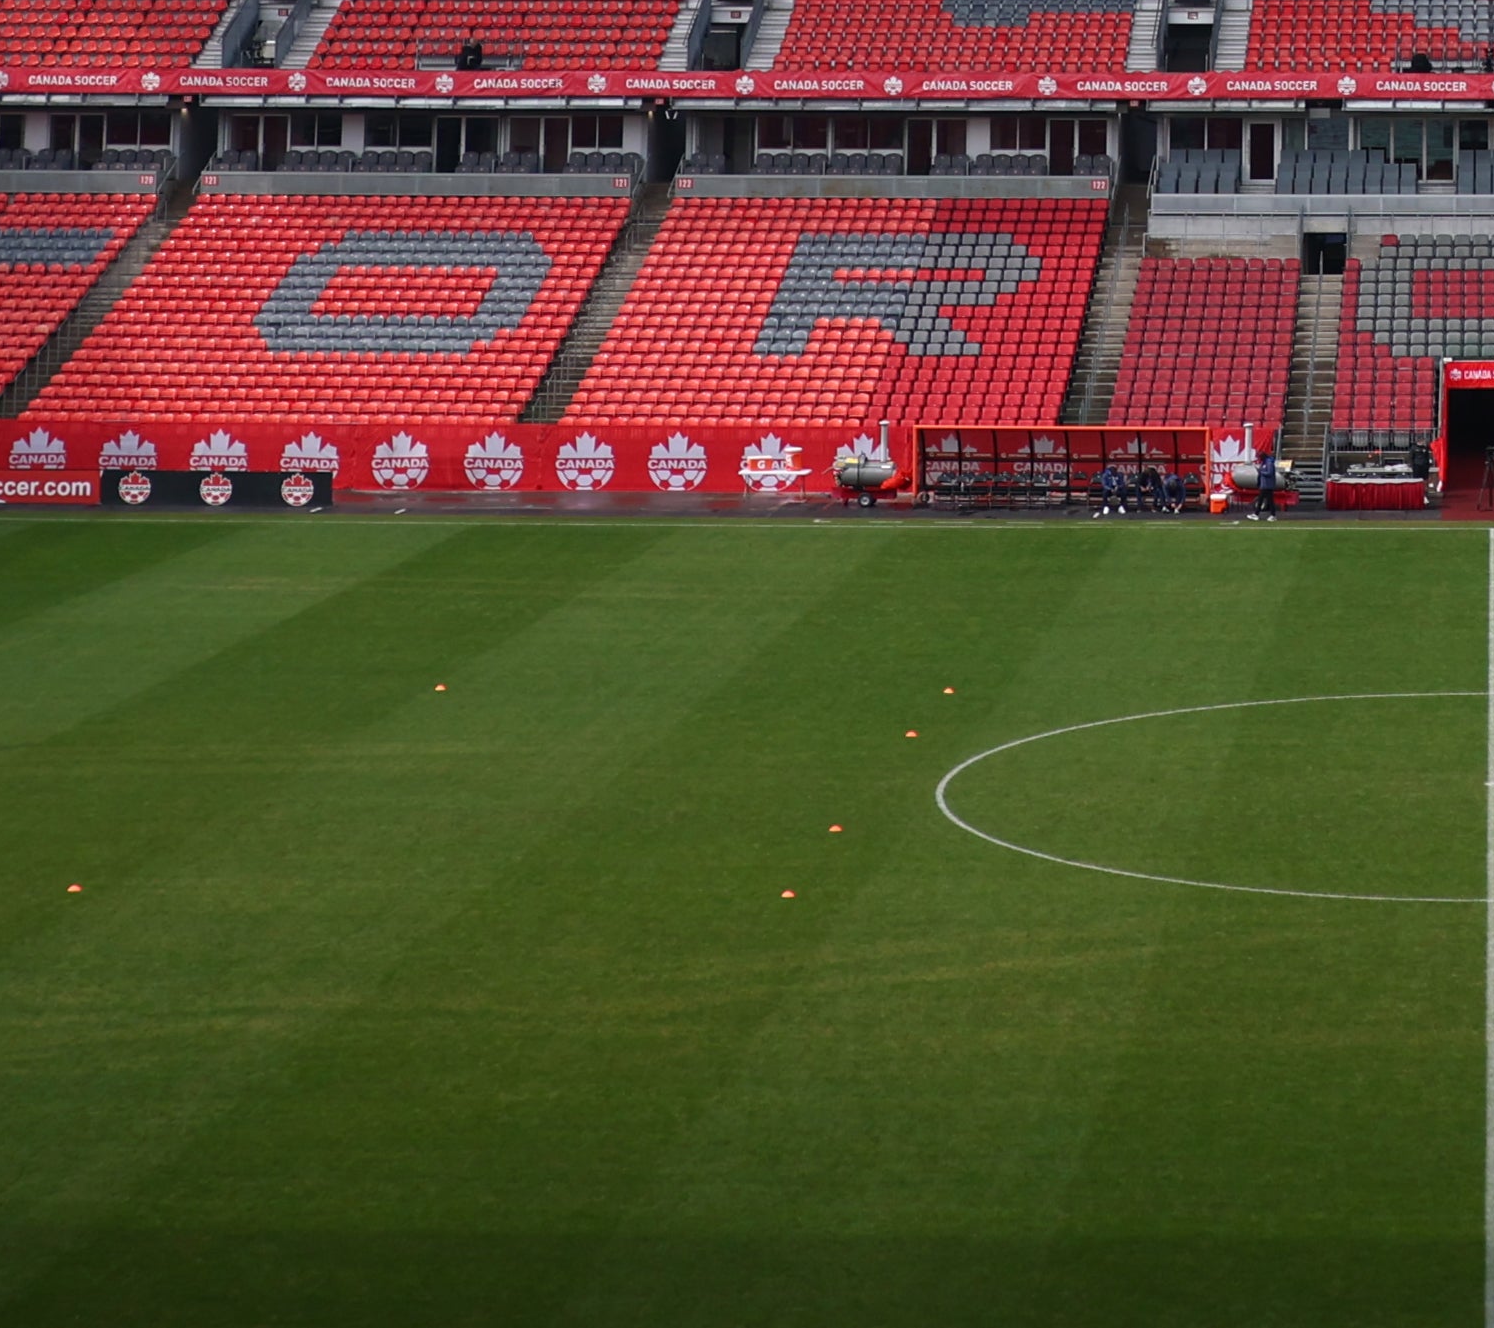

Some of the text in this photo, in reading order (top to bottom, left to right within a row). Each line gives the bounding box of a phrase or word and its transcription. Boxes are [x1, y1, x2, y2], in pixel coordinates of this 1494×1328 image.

[28, 75, 117, 86] CANADA SOCCER
[179, 76, 267, 87] CANADA SOCCER
[325, 77, 415, 89] CANADA SOCCER
[473, 78, 563, 89] CANADA SOCCER
[625, 78, 715, 90] CANADA SOCCER
[773, 79, 864, 91] CANADA SOCCER
[921, 80, 1013, 91] CANADA SOCCER
[1076, 80, 1168, 92] CANADA SOCCER
[1226, 80, 1317, 91] CANADA SOCCER
[1375, 80, 1466, 92] CANADA SOCCER
[204, 175, 217, 184] 121
[615, 178, 627, 187] 121
[678, 179, 692, 188] 122
[1092, 180, 1107, 190] 122
[1463, 369, 1492, 381] CANADA
[9, 454, 66, 464] CANADA
[98, 456, 156, 466] CANADA
[189, 457, 247, 467] CANADA
[280, 458, 338, 469] CANADA
[371, 458, 429, 469] CANADA
[464, 459, 523, 469] CANADA
[555, 459, 615, 470] CANADA
[647, 459, 707, 470] CANADA
